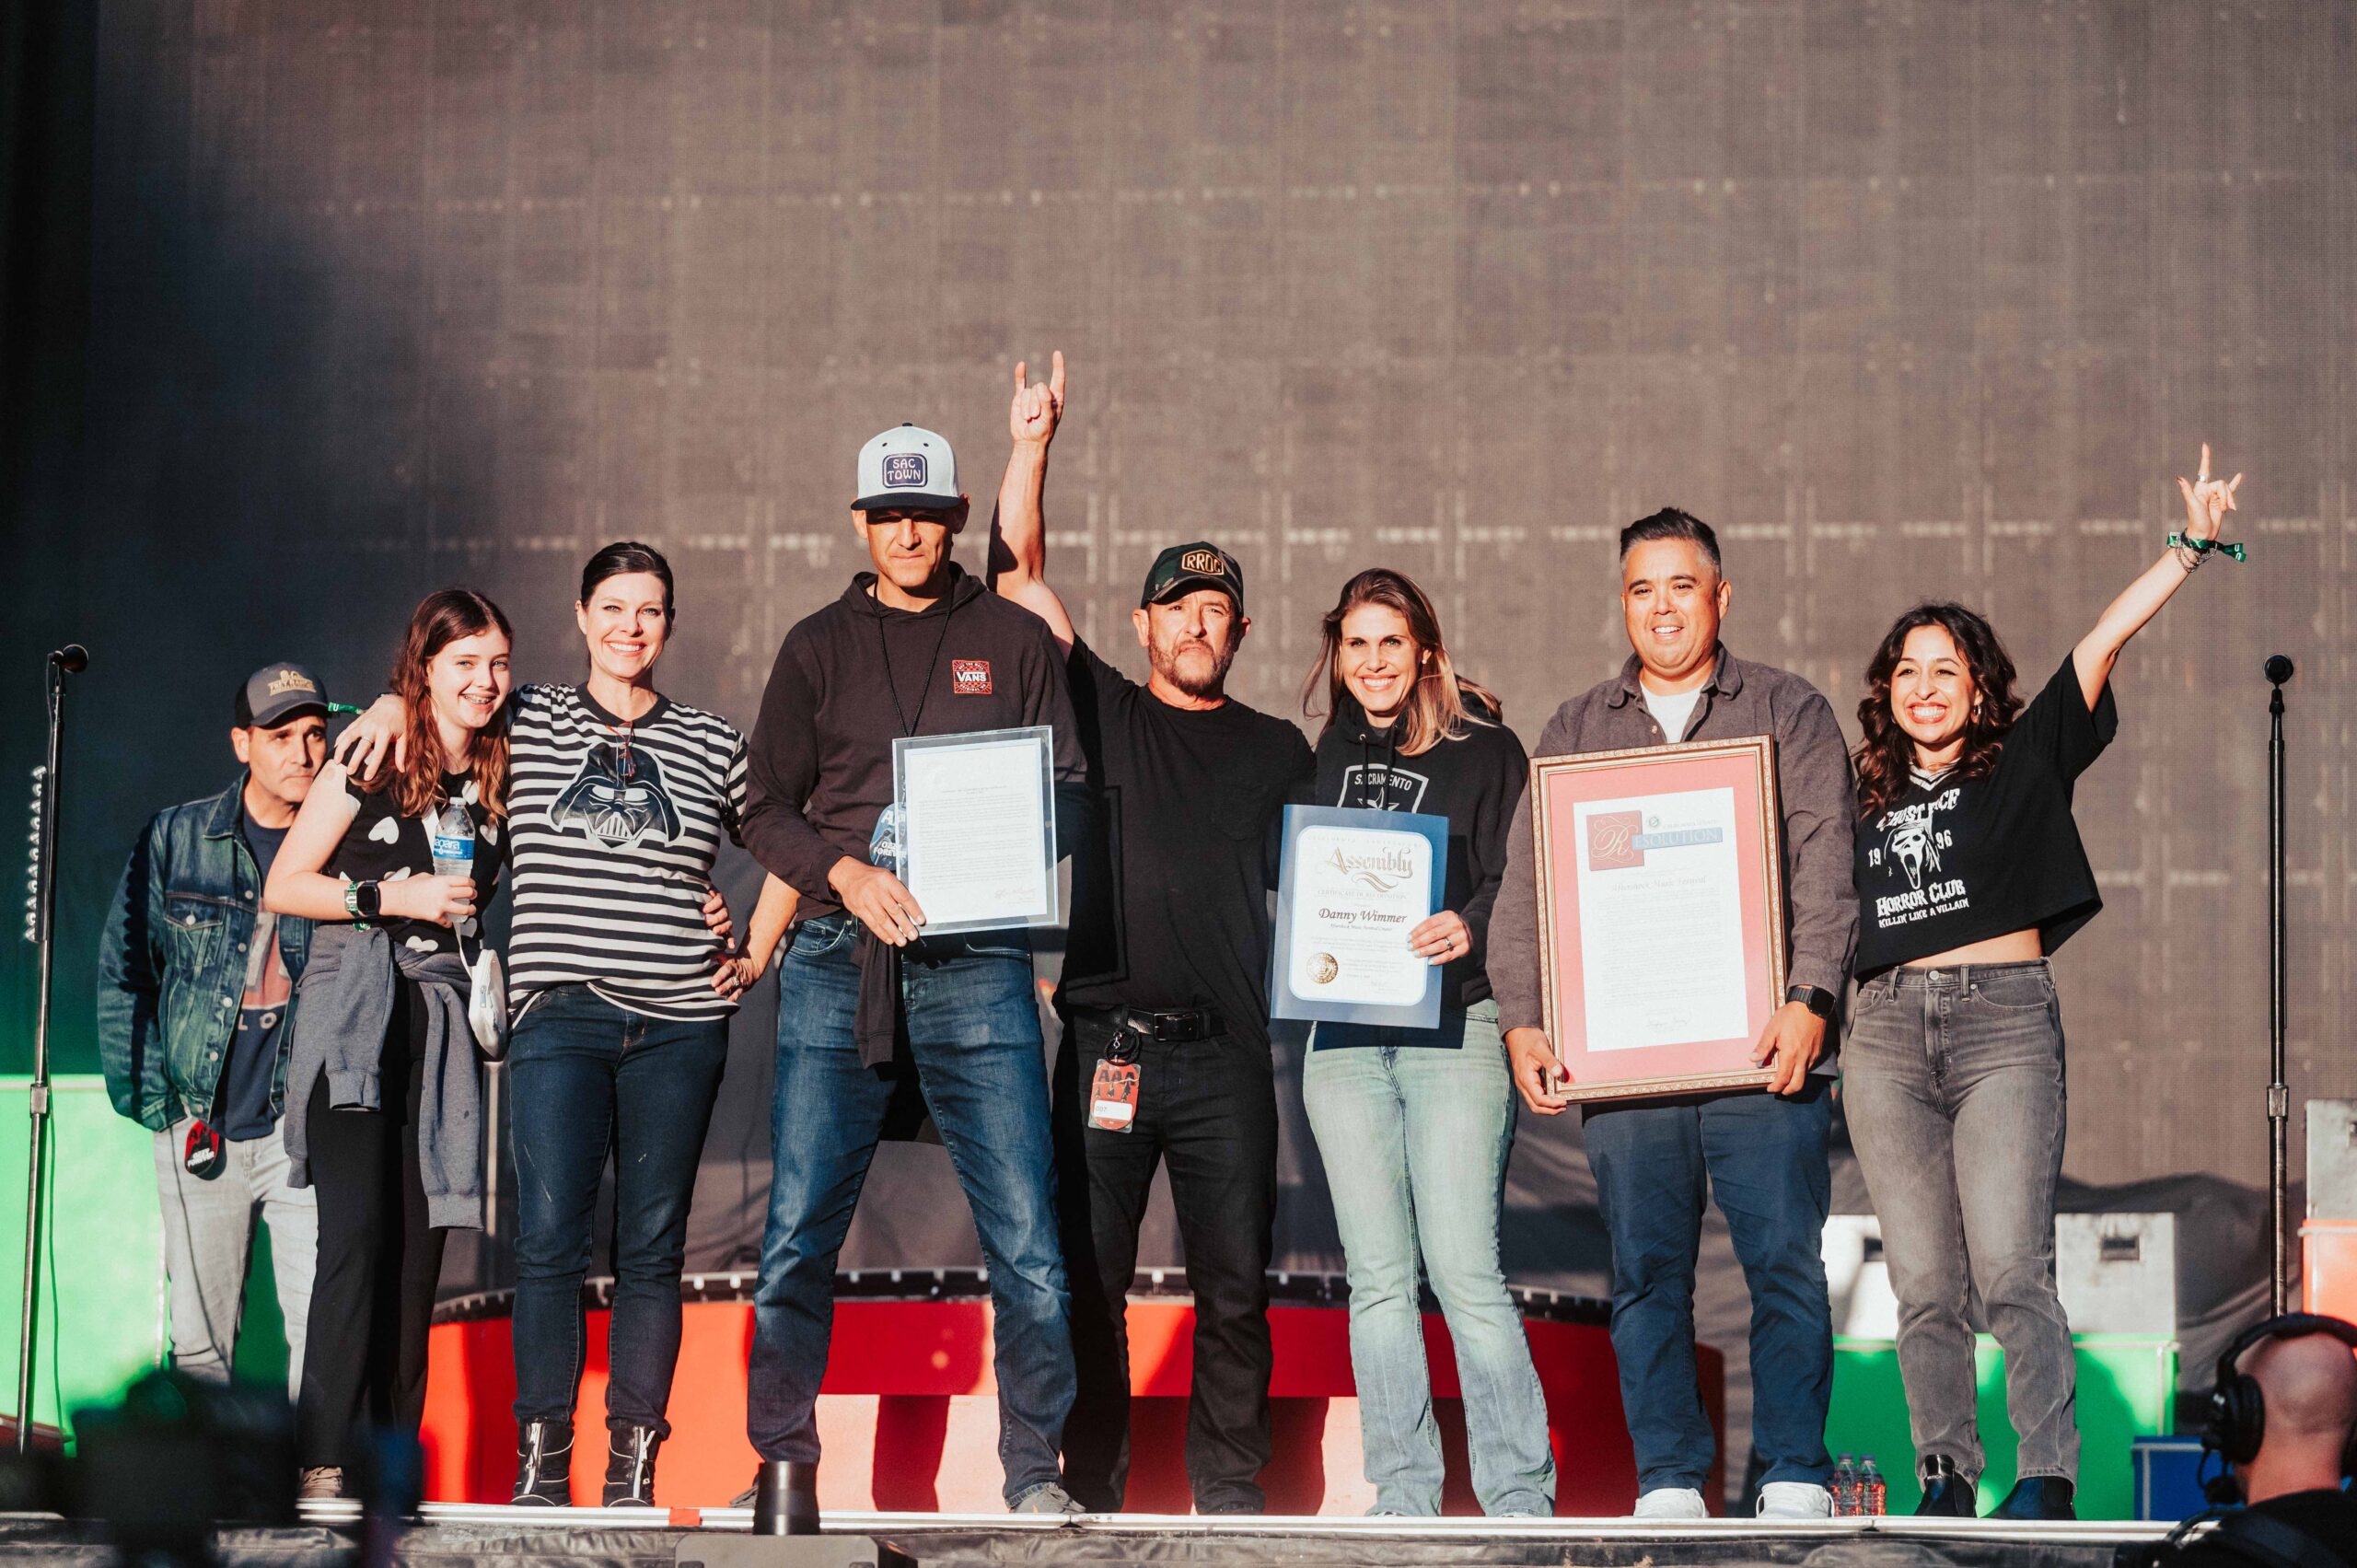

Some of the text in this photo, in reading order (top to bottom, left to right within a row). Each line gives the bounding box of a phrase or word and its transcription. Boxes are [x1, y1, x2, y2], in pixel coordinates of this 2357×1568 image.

[893, 459, 915, 469] SAC
[888, 470, 921, 481] TOWN
[957, 672, 987, 682] VANS
[1354, 773, 1412, 791] SCRAMENTO
[1935, 830, 1953, 849] 96
[1322, 846, 1413, 878] Assembly
[1868, 847, 1881, 867] 19
[1875, 879, 1966, 917] HORROR CLUB
[1318, 908, 1407, 923] Danny Wimmer
[1909, 910, 1928, 922] LIKE
[1930, 907, 1936, 916] A
[1936, 898, 1969, 914] VILLAIN
